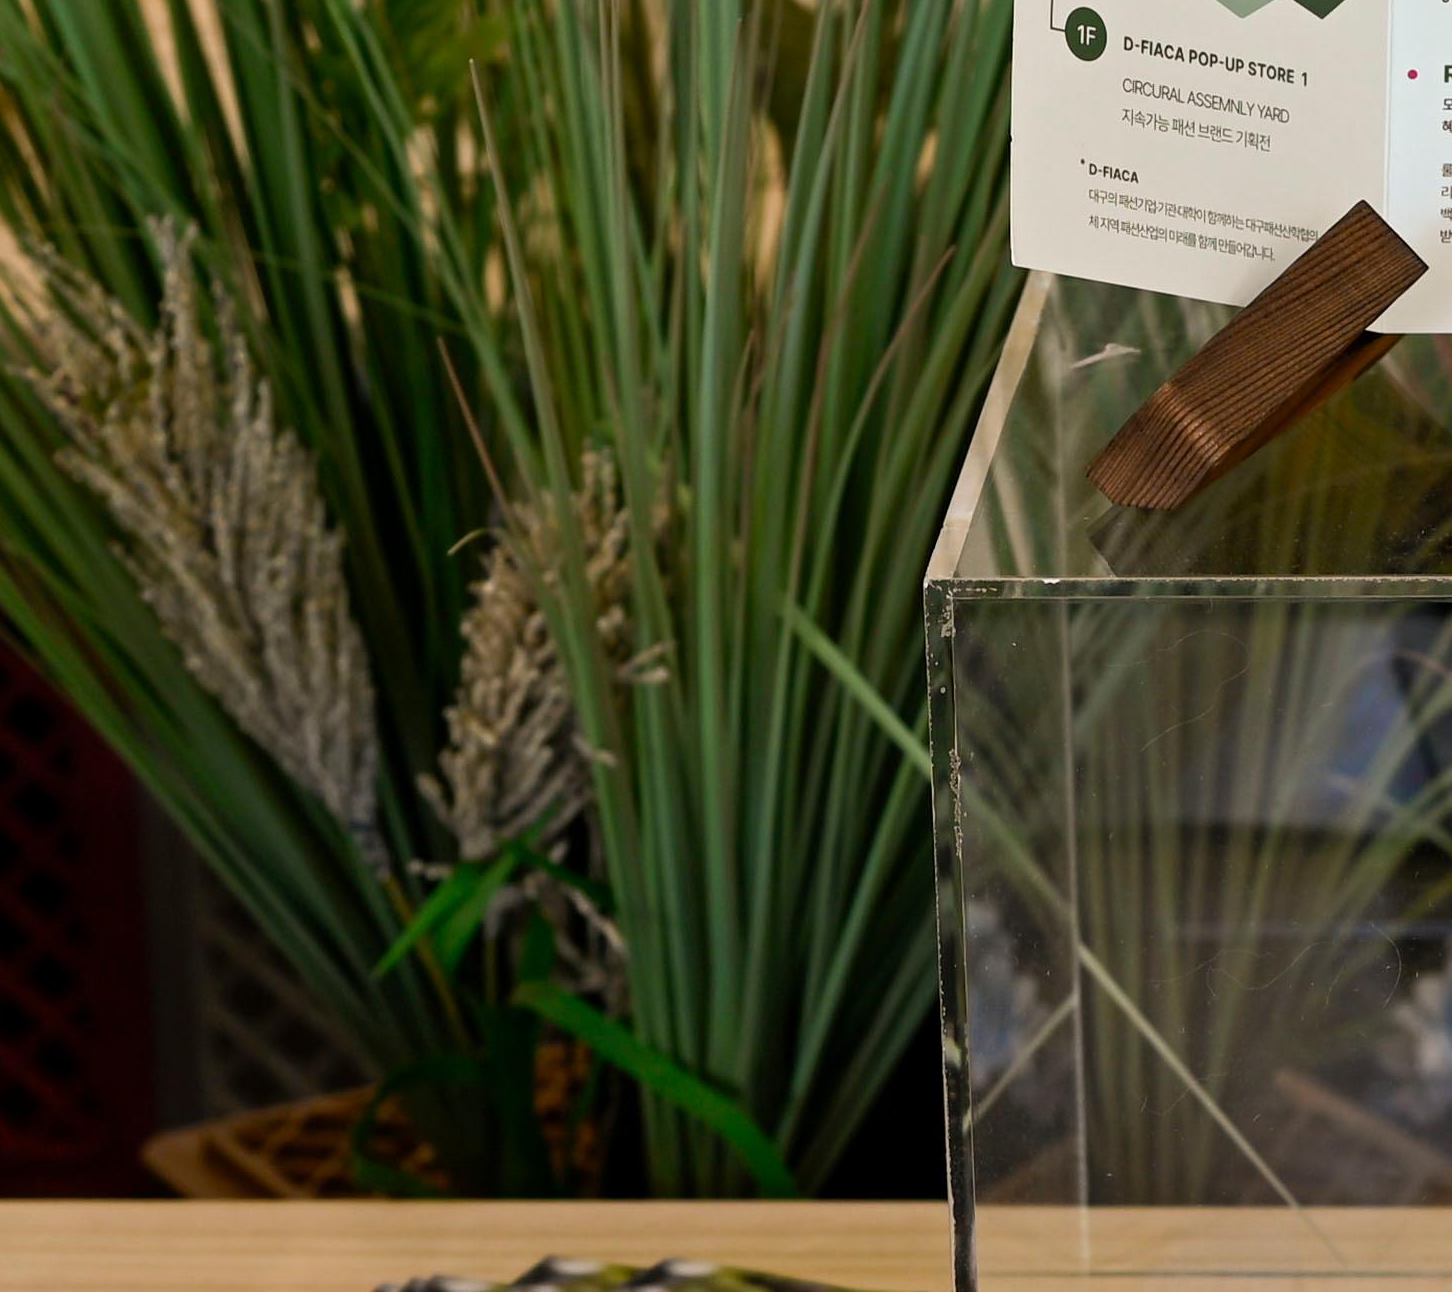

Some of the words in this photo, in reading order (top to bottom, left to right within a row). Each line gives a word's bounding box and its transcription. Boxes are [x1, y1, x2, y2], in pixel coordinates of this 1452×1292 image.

[1077, 24, 1097, 46] 1F
[1123, 36, 1186, 64] D-FIACA
[1189, 50, 1244, 74] POP-UP
[1247, 61, 1295, 84] STORE
[1302, 72, 1308, 87] 1
[1122, 78, 1185, 104] CIRCURAL
[1257, 103, 1290, 124] YARD
[1121, 109, 1170, 132] 지속가능
[1172, 118, 1196, 138] 패션
[1198, 123, 1234, 144] 브랜드
[1236, 129, 1271, 152] 기획전
[1088, 163, 1139, 184] D-FIACA
